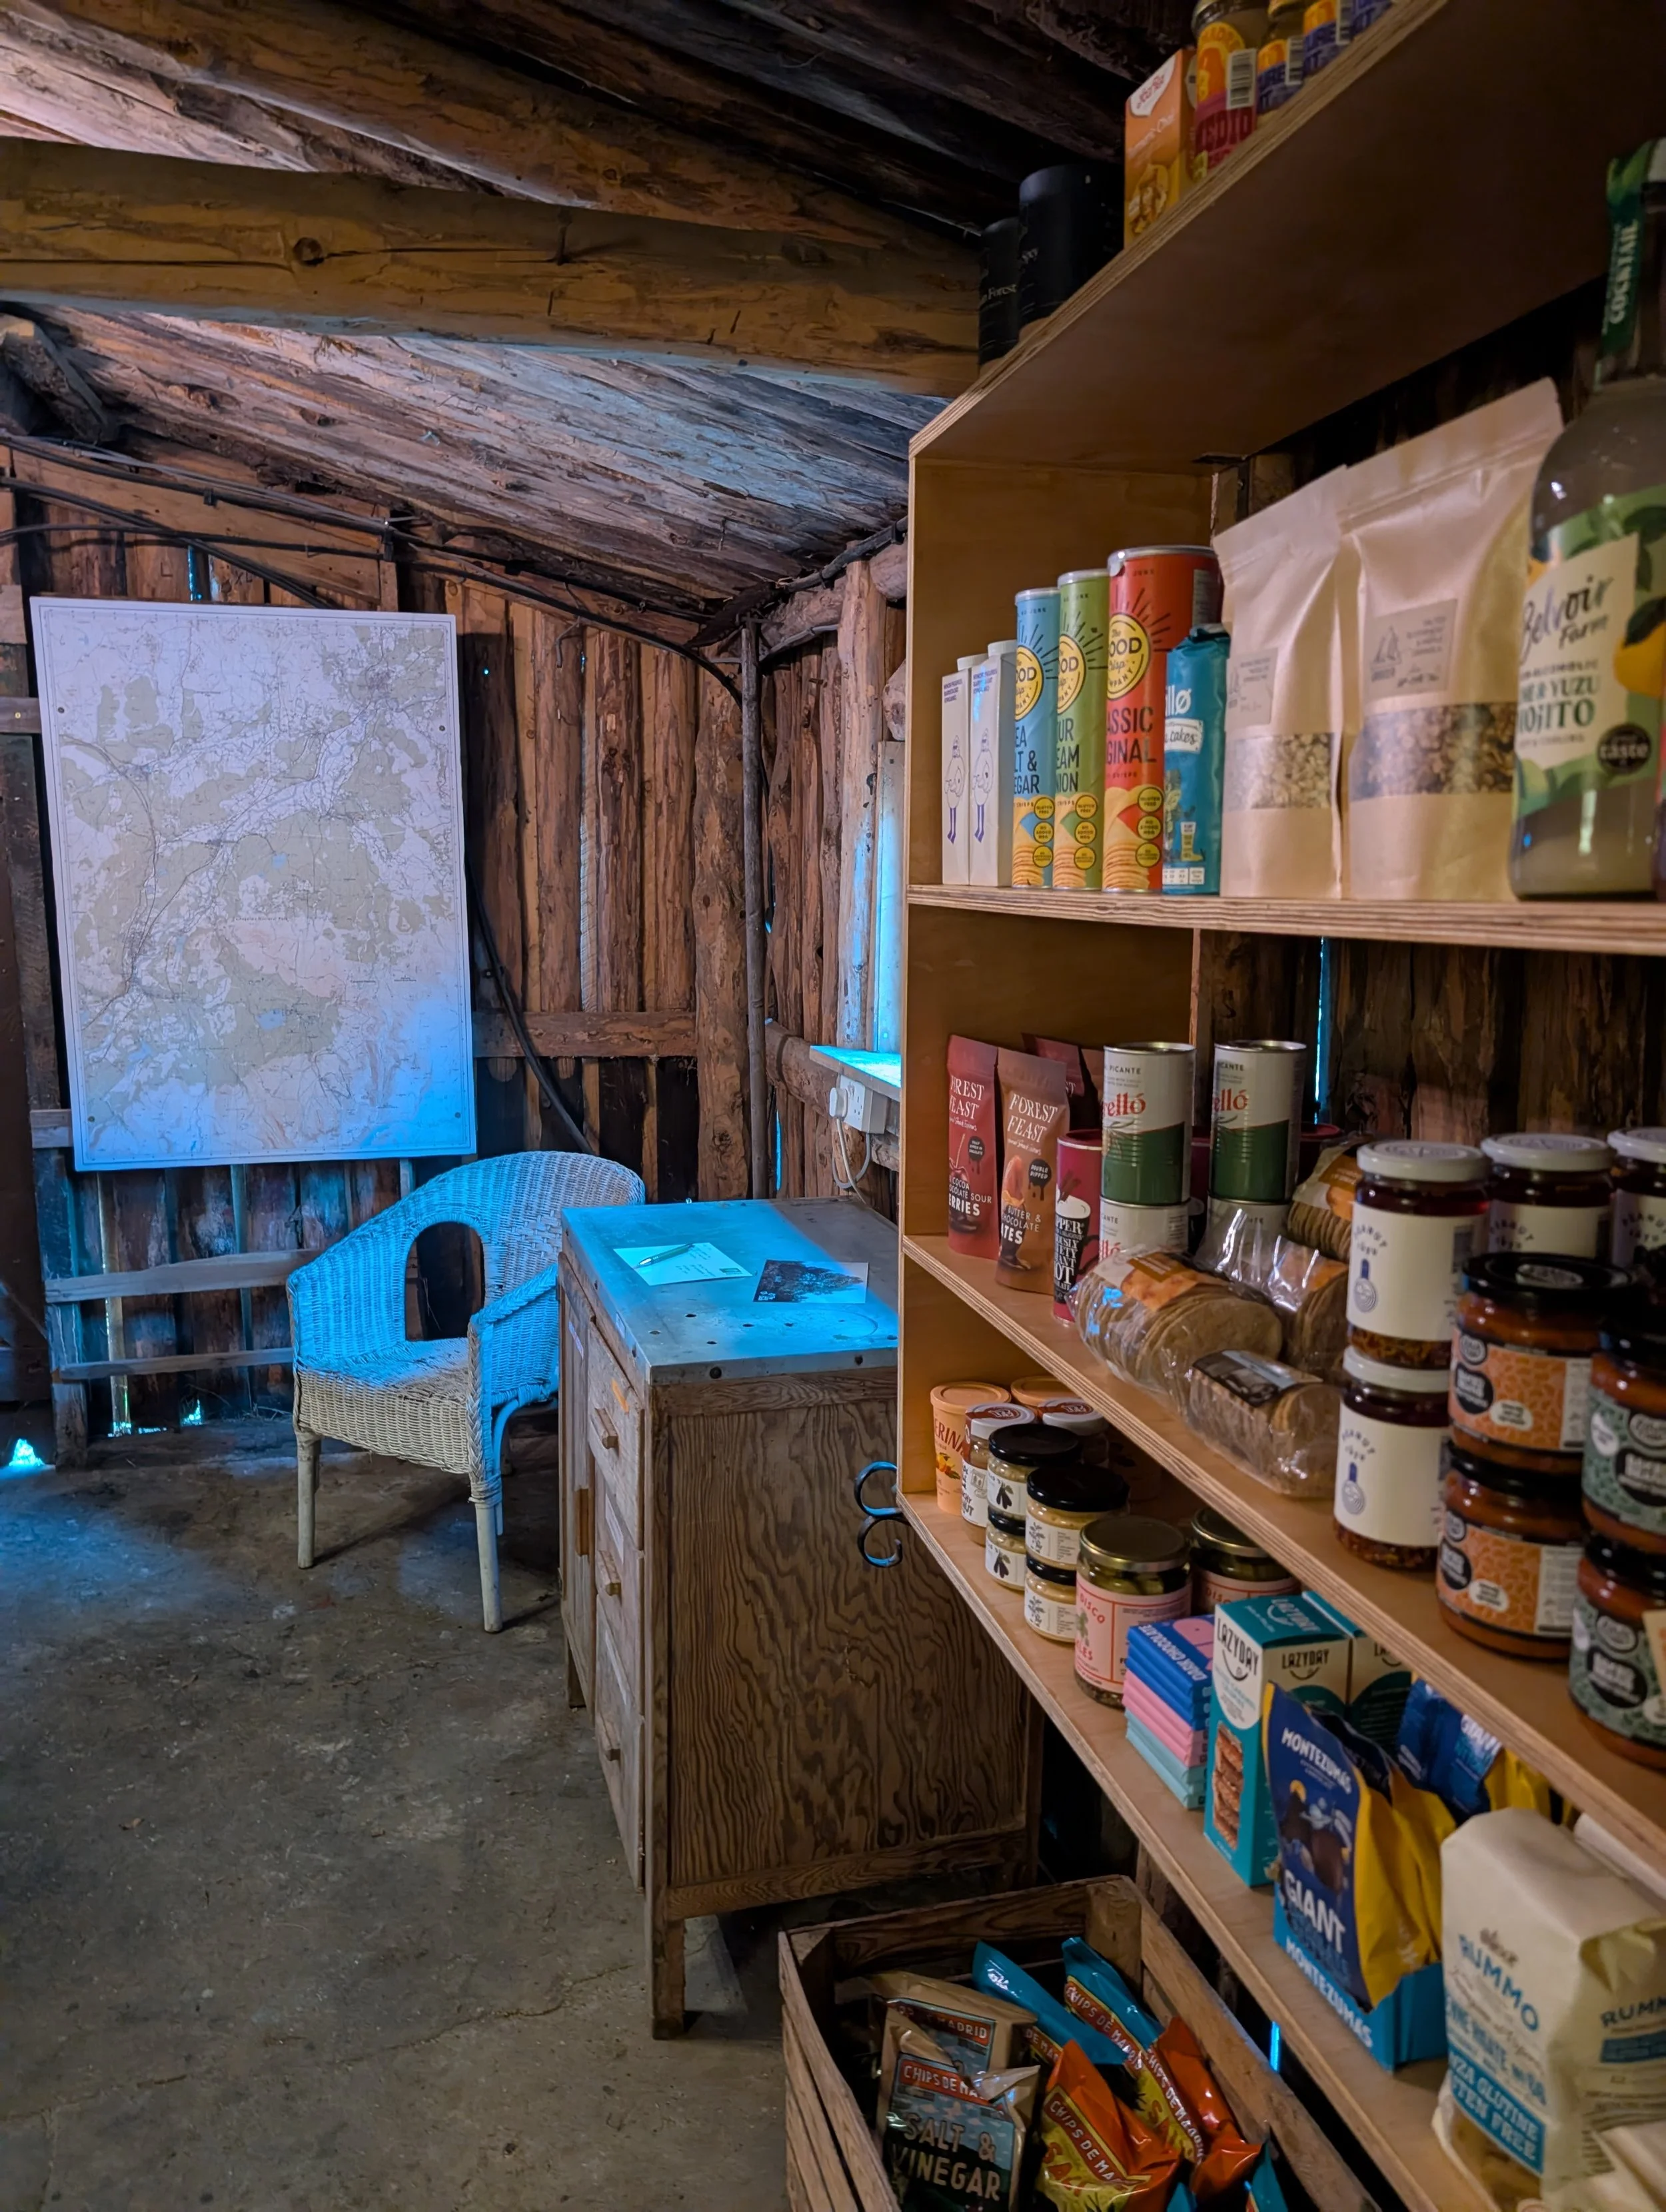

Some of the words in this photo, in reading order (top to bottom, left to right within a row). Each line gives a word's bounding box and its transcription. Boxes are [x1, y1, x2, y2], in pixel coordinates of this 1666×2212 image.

[1520, 574, 1614, 667] Belvoir
[1558, 614, 1608, 650] Farm
[1551, 674, 1598, 698] YUZU
[1027, 750, 1037, 773] &
[1109, 1065, 1141, 1075] PICANTE
[1010, 1093, 1058, 1123] FOREST
[1007, 1115, 1048, 1143] FEAST
[1030, 1171, 1048, 1180] DIPPED
[1031, 1164, 1048, 1173] DOUBLE
[952, 1177, 970, 1191] COCOA
[970, 1192, 992, 1204] SOUR
[1007, 1205, 1031, 1221] BUTTER
[1034, 1214, 1041, 1223] &
[1080, 1592, 1106, 1624] DISCO
[1217, 1618, 1259, 1676] LAZYDAY
[1281, 1648, 1330, 1670] LAZYDAY
[1284, 1868, 1347, 1954] GIANT
[1458, 1934, 1539, 2033] RUMMO
[937, 2017, 988, 2039] MADRID
[1096, 2013, 1114, 2031] DE
[1025, 2028, 1040, 2045] DE
[903, 2065, 940, 2087] CHIPS
[942, 2077, 957, 2092] DE
[904, 2111, 966, 2153] SALT
[978, 2131, 997, 2163] &
[1050, 2099, 1084, 2139] CHIPS
[1080, 2139, 1100, 2161] DE
[892, 2142, 1000, 2201] VINEGAR
